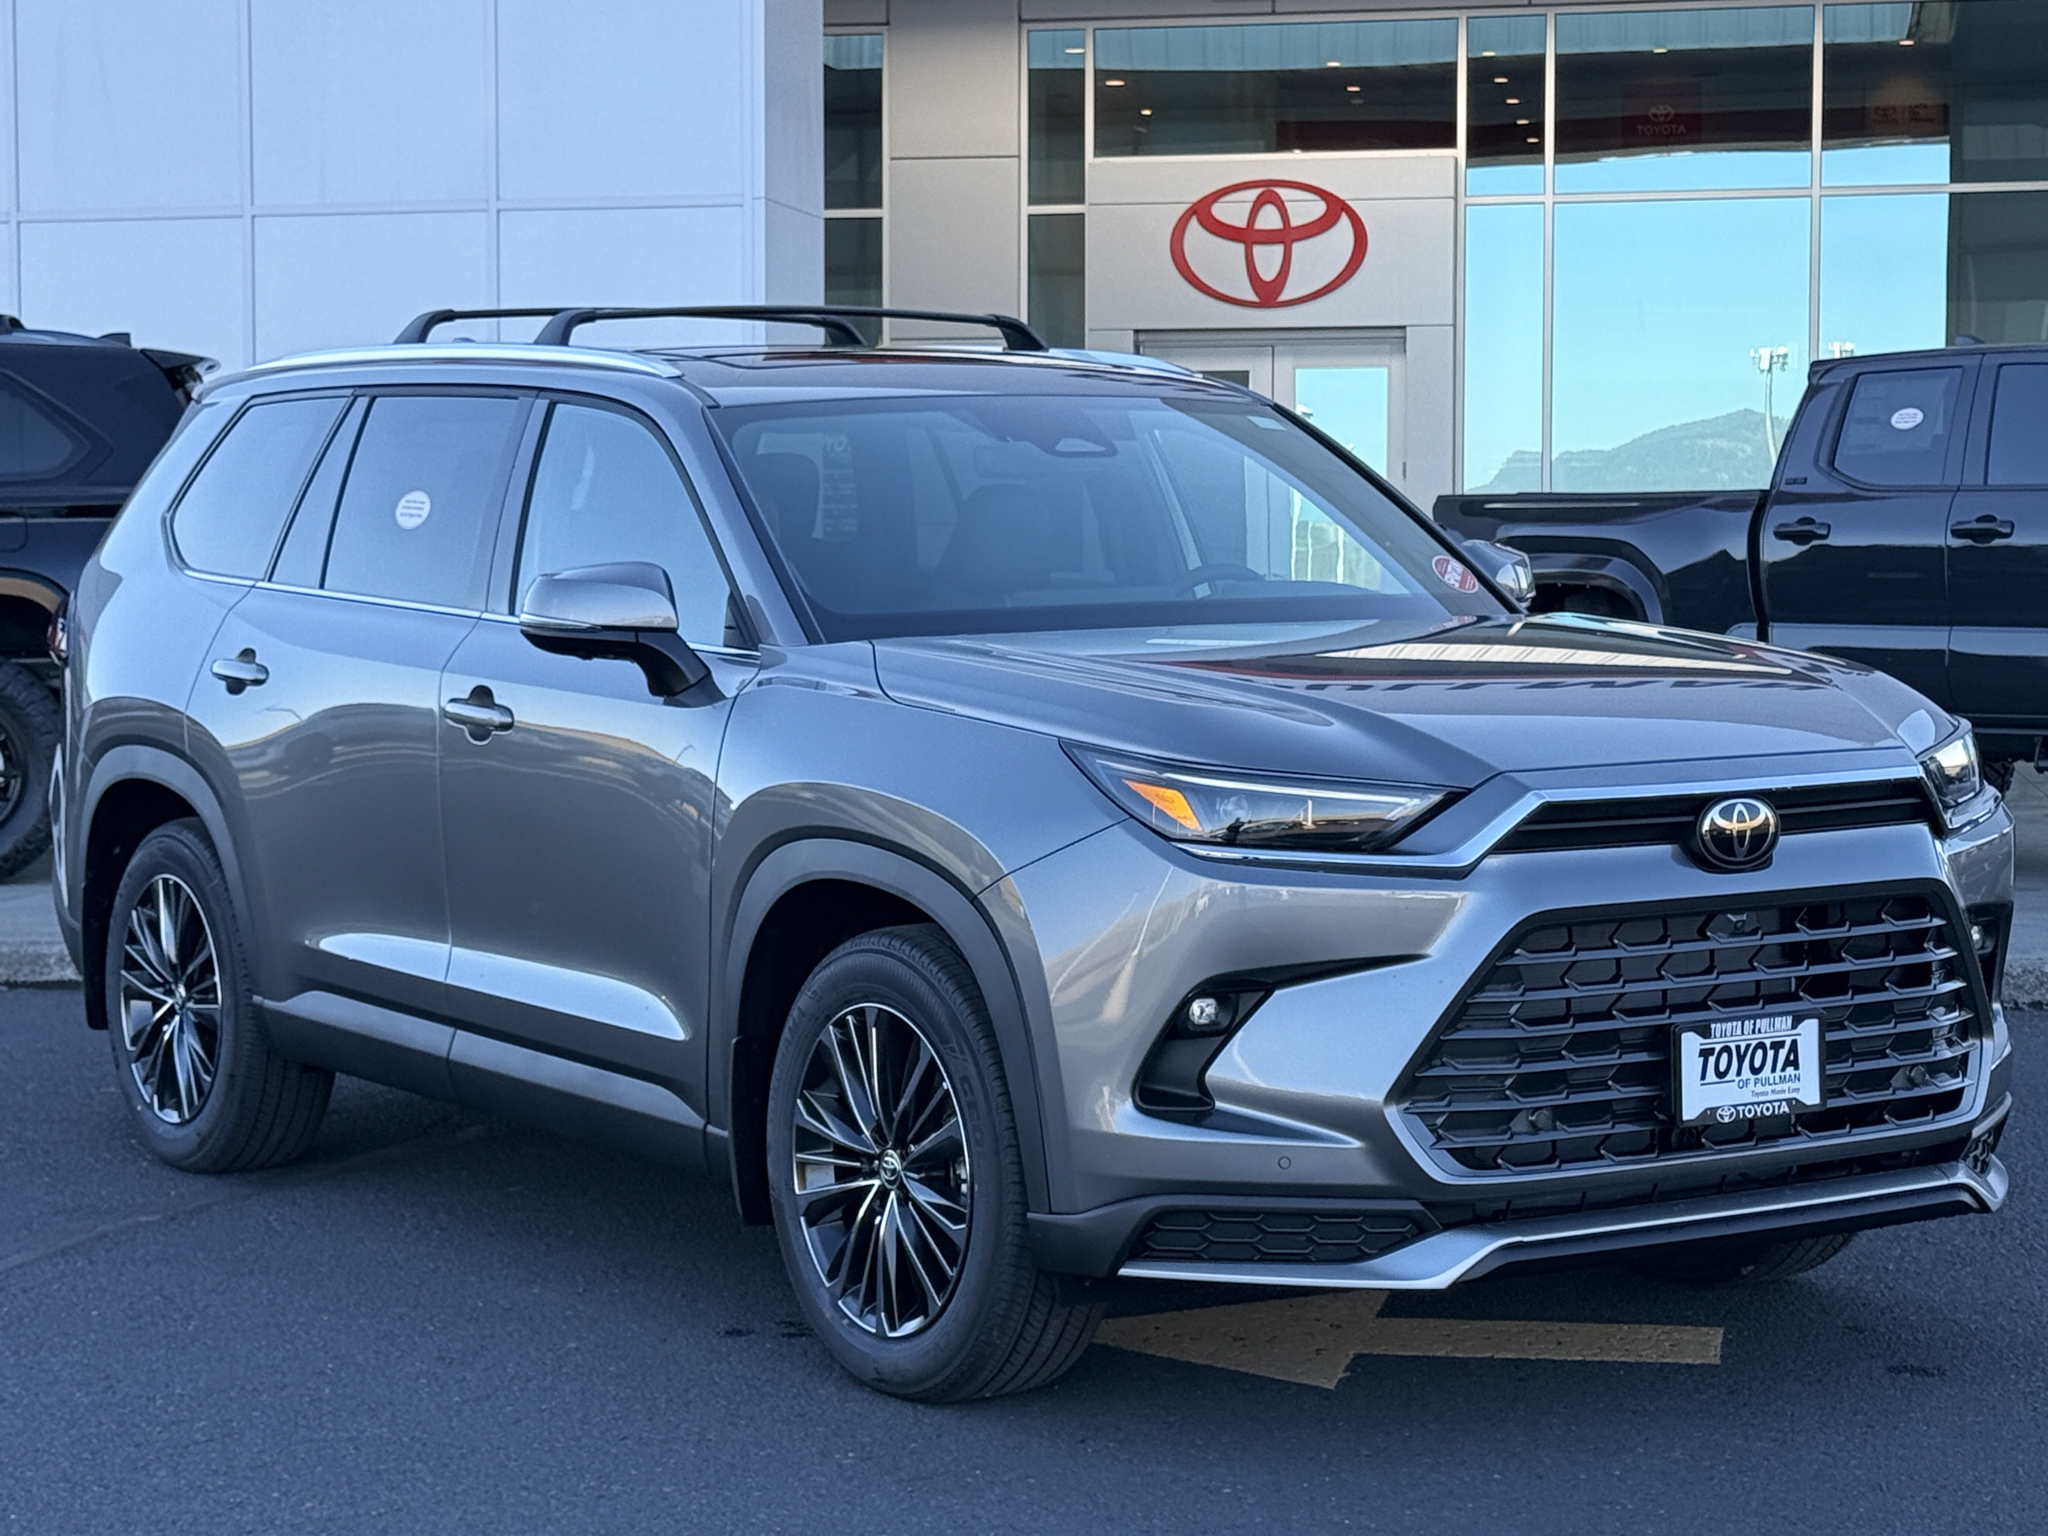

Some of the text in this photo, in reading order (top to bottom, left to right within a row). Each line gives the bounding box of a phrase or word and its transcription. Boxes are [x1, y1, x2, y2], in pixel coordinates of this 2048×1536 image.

[1637, 124, 1687, 136] TOYOTA
[1710, 1016, 1793, 1038] TOYOTA OF PULLMAN
[1698, 1039, 1800, 1081] TOYOTA
[1737, 1073, 1801, 1090] OF PULLMAN
[1751, 1089, 1769, 1099] Toyota
[1736, 1101, 1790, 1119] TOYOTA
